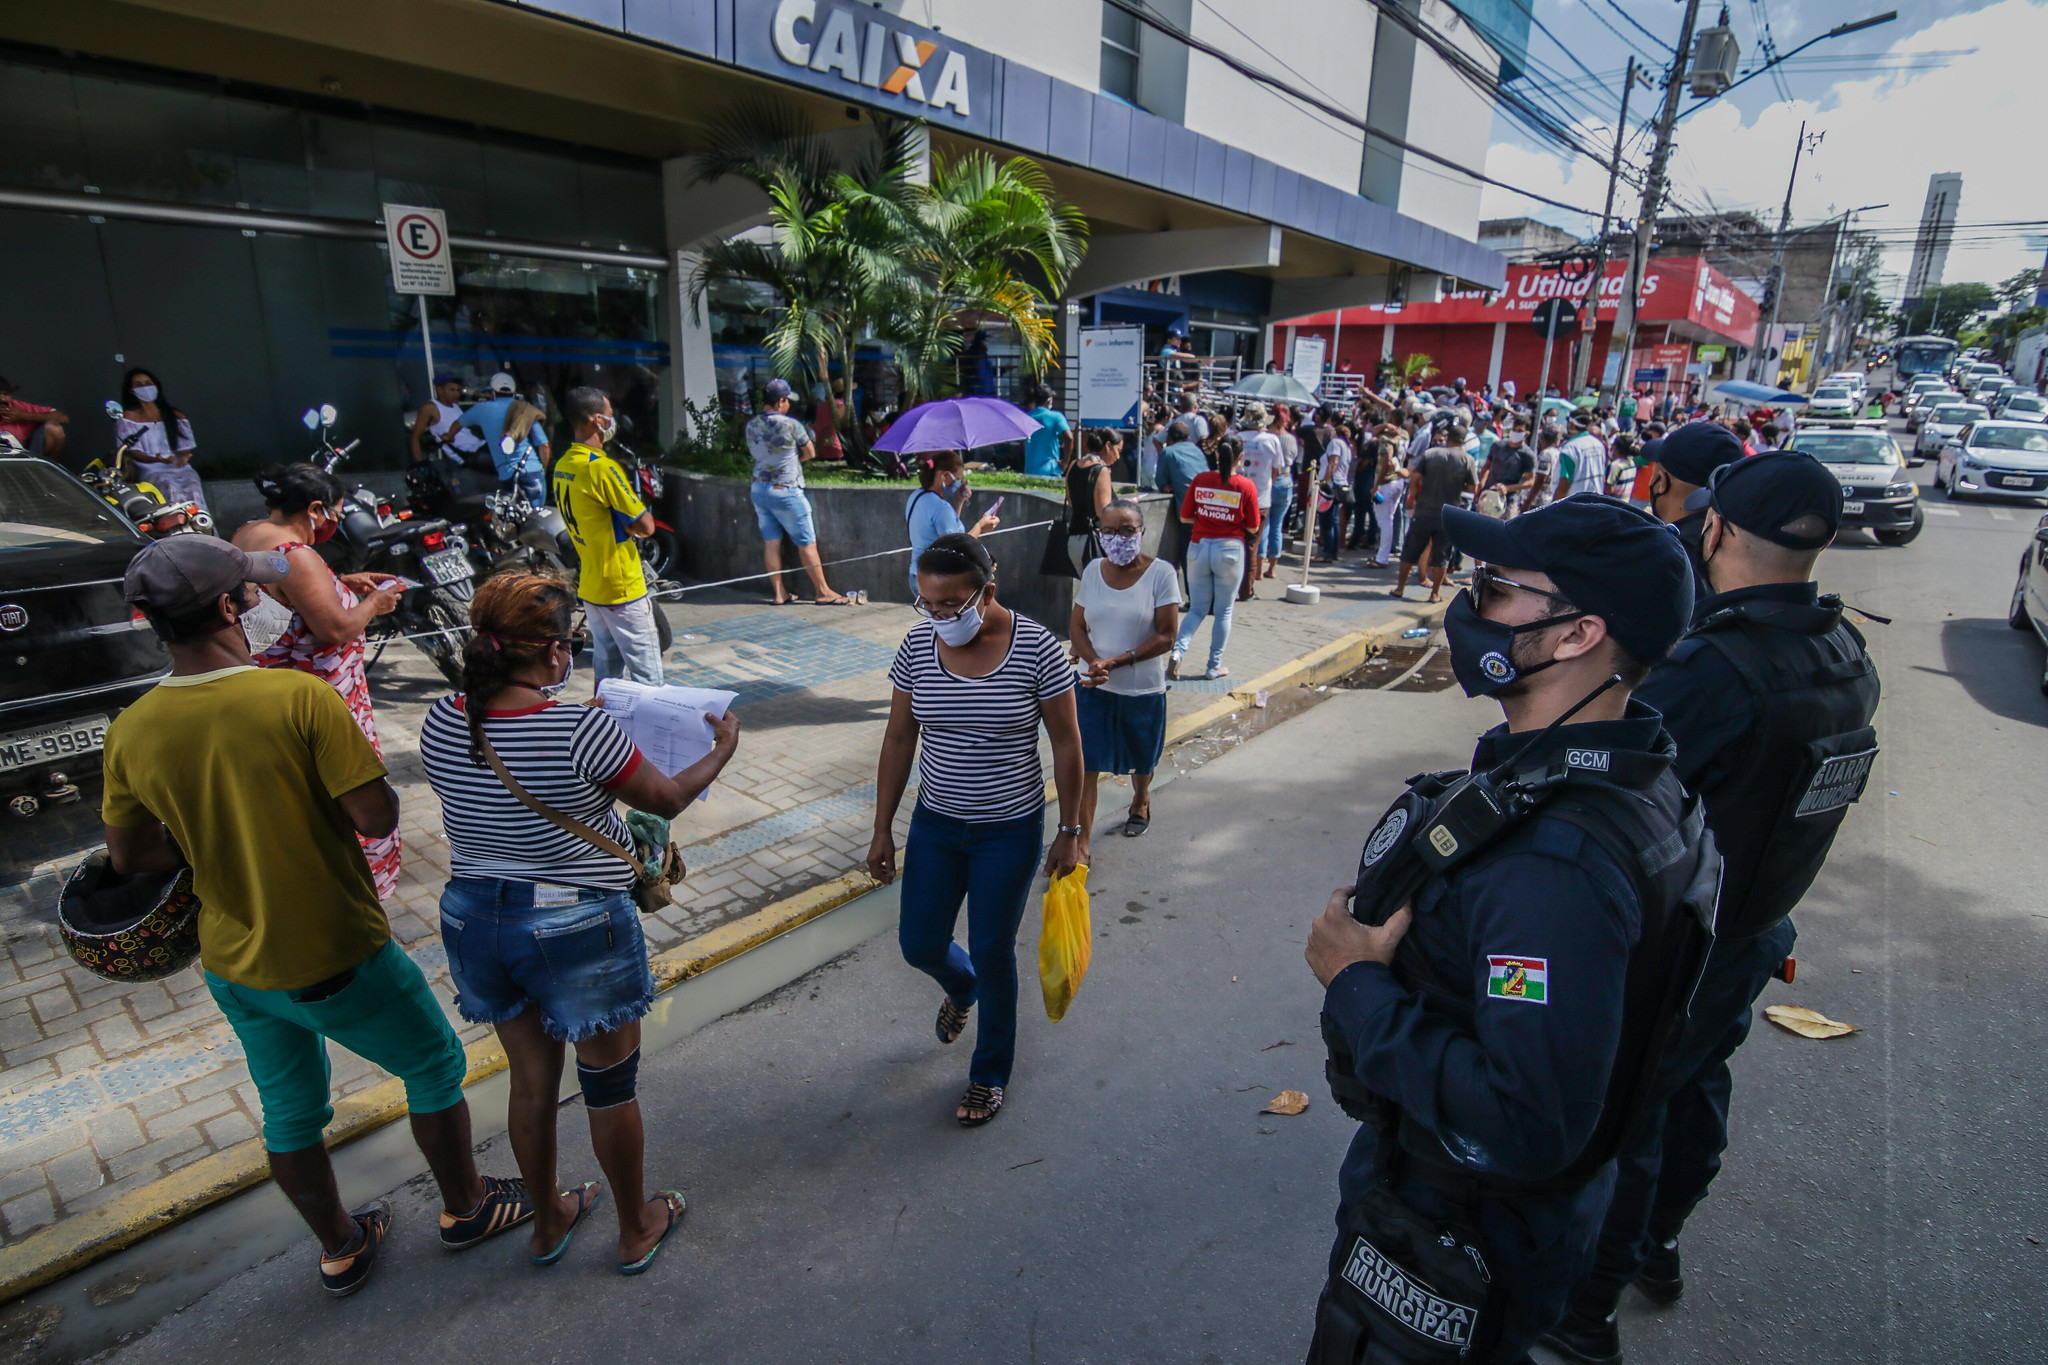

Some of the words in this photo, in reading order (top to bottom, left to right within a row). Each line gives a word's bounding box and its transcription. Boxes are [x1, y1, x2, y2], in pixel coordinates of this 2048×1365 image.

[772, 0, 970, 116] CAIXA
[409, 223, 429, 250] E
[1518, 269, 1660, 297] Utilidads
[555, 481, 580, 535] 14
[1209, 510, 1235, 522] HORA!
[1, 611, 21, 626] FIAT
[0, 726, 105, 768] ME-9995
[1568, 751, 1607, 769] GCM
[1813, 755, 1872, 787] GUARDA
[1479, 789, 1501, 815] MOTOROLA
[1358, 1245, 1469, 1324] GUARDA
[1347, 1257, 1466, 1343] MUNICIPAL
